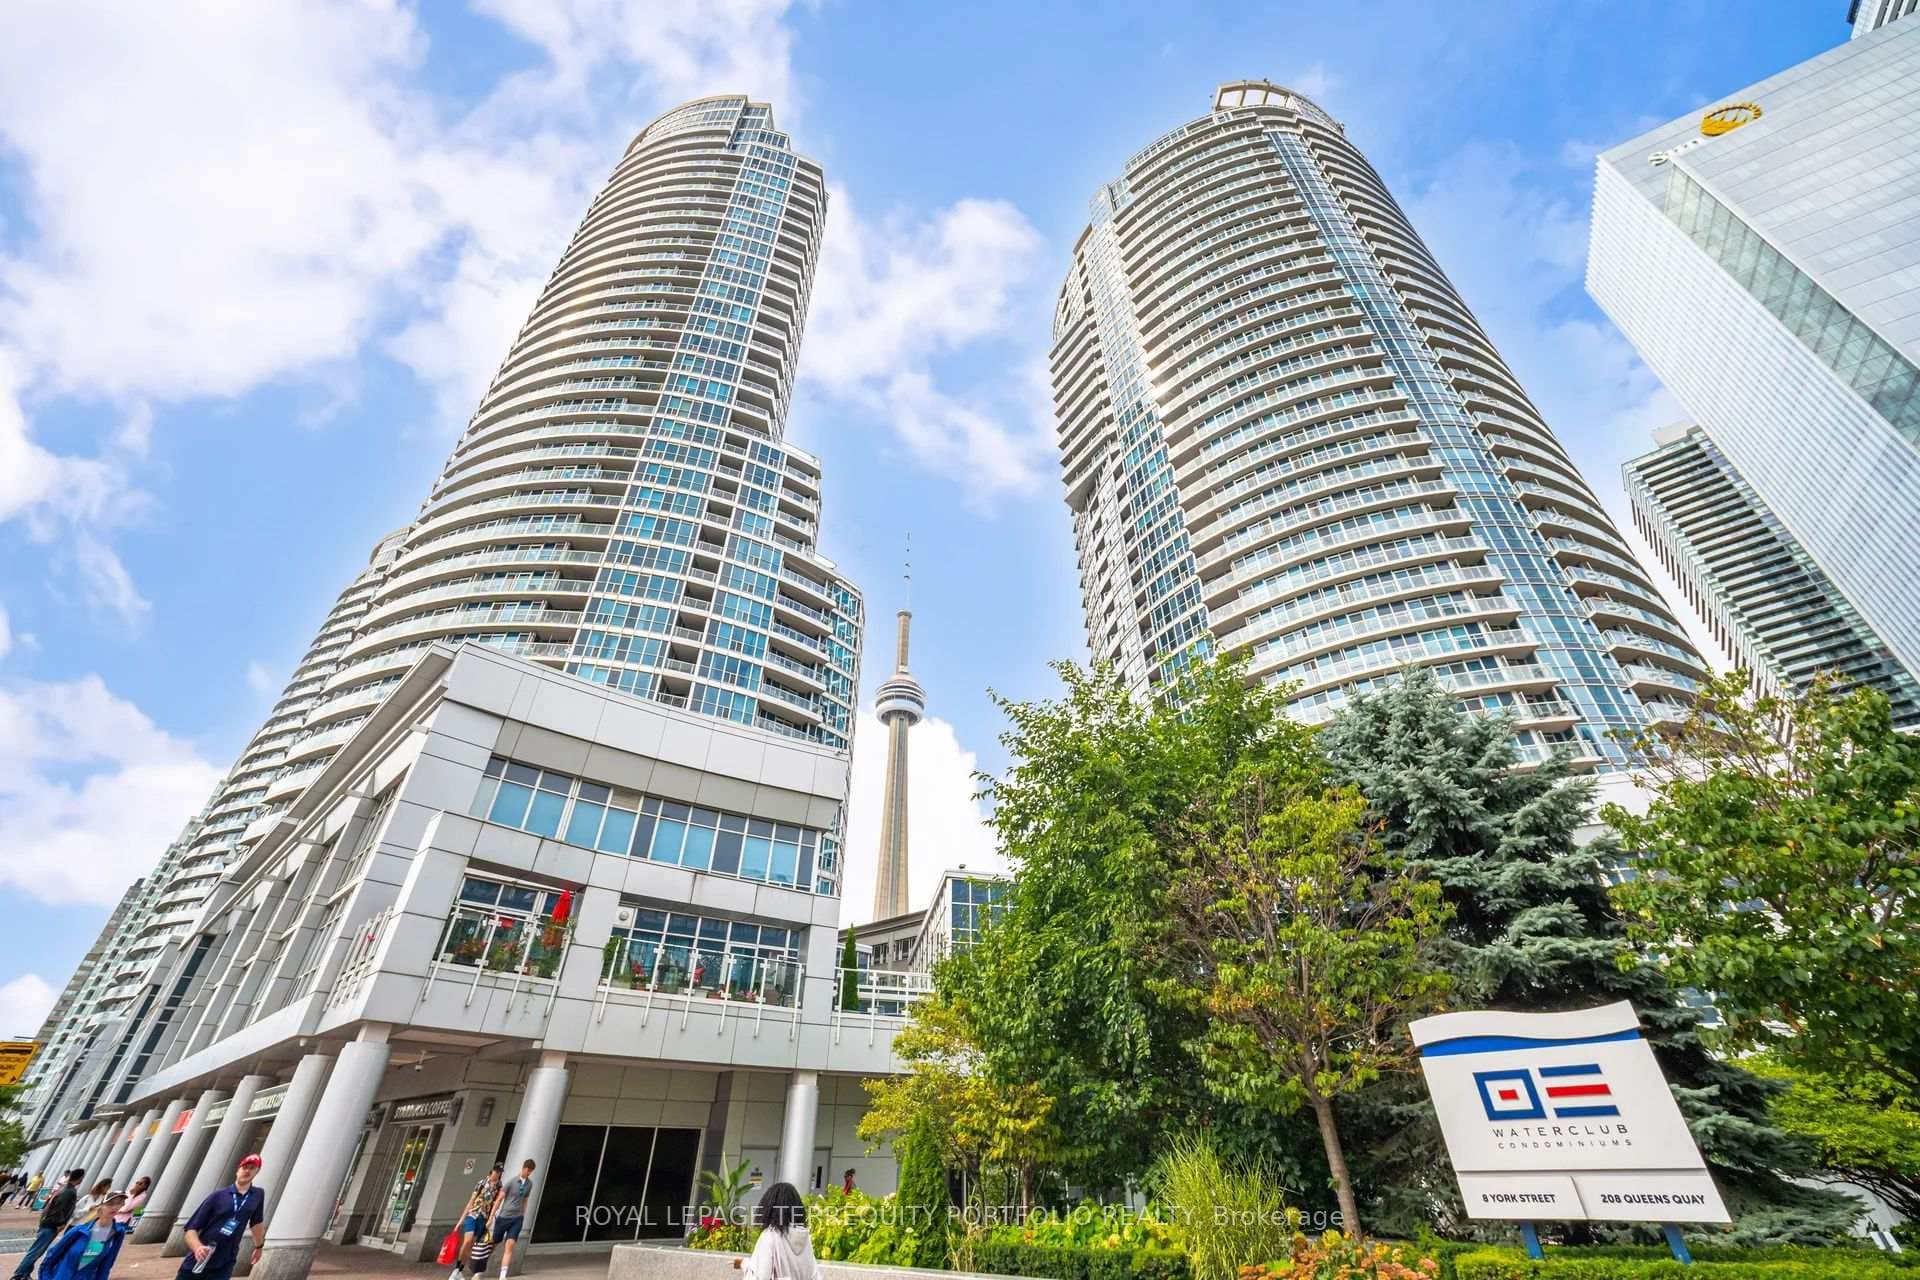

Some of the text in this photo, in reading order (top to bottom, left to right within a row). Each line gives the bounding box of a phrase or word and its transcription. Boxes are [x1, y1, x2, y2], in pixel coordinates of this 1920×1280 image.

[1492, 1124, 1628, 1138] WATERCLUB
[1497, 1139, 1632, 1149] CONDOMINIUMS
[1482, 1194, 1556, 1203] 8 YORK STREET
[1600, 1194, 1705, 1205] 208 QUEENS QUAY
